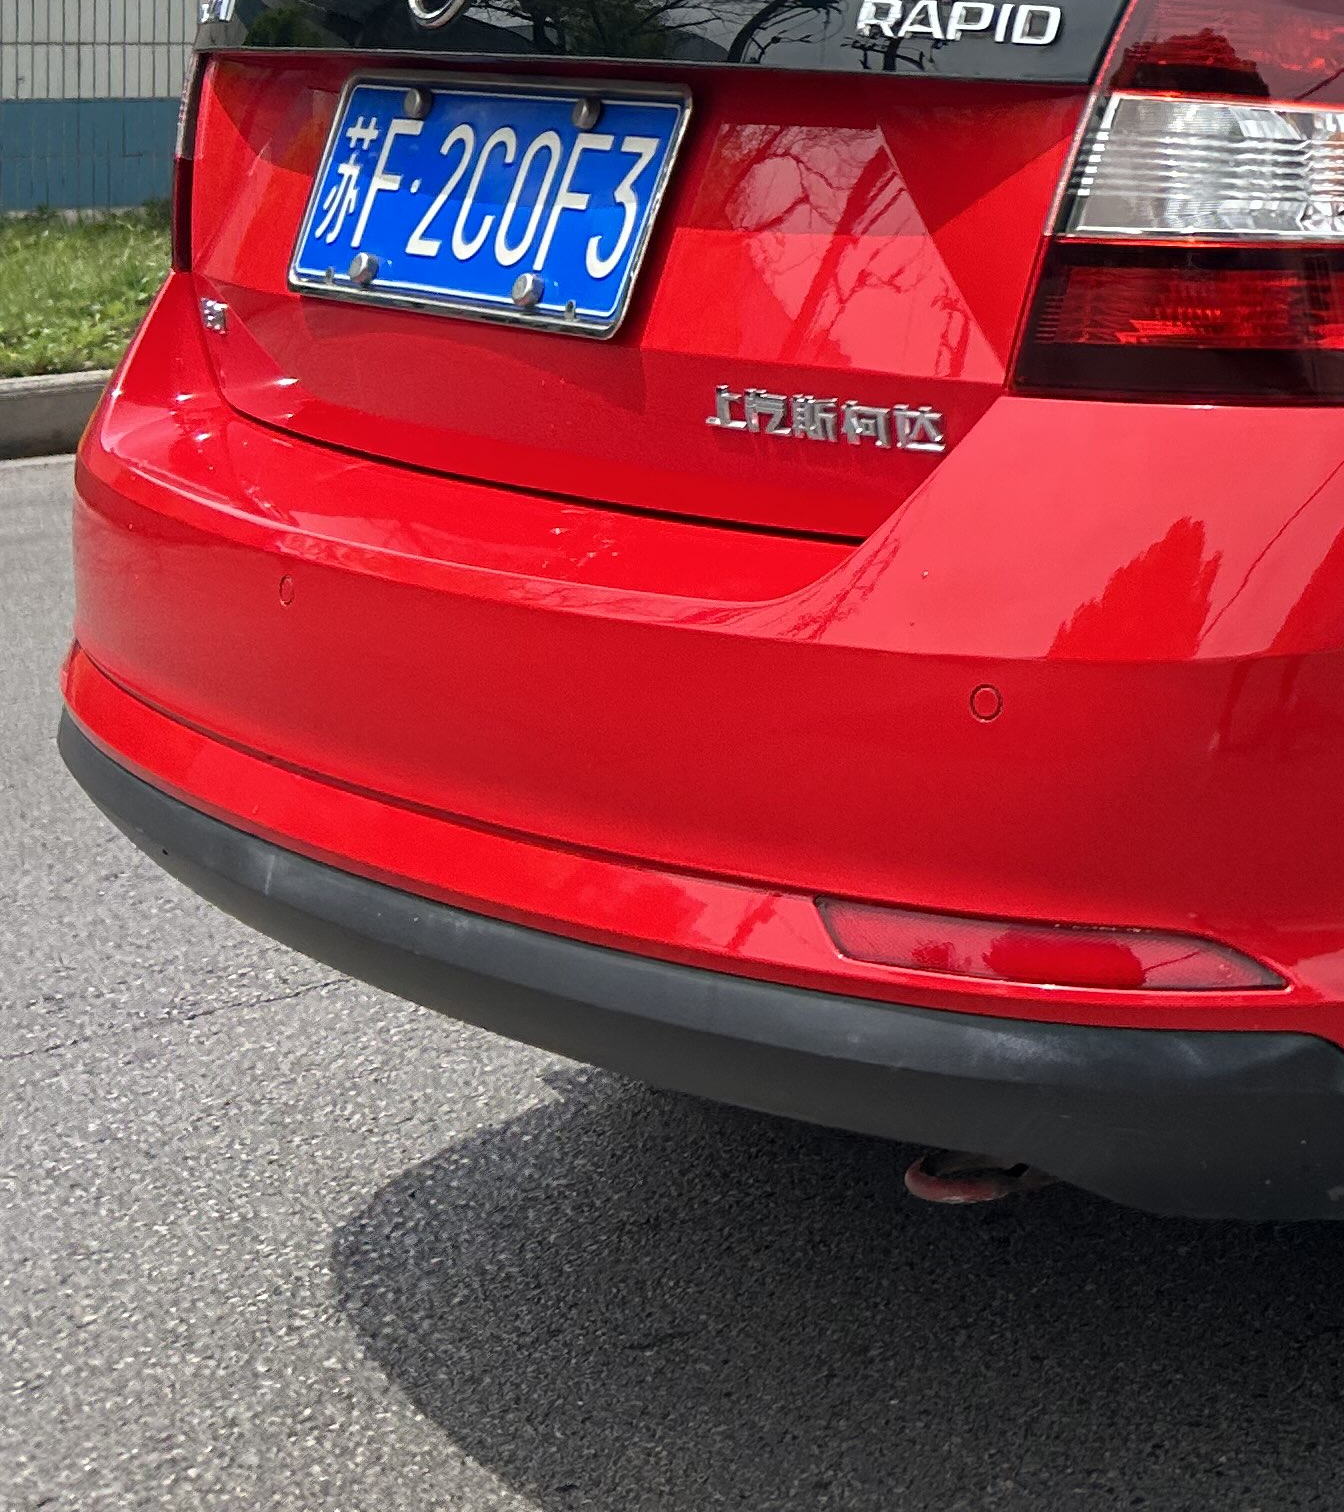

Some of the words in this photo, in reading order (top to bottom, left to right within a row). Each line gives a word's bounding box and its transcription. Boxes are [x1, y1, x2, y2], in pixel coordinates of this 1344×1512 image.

[705, 384, 946, 453] 上汽斯柯达
